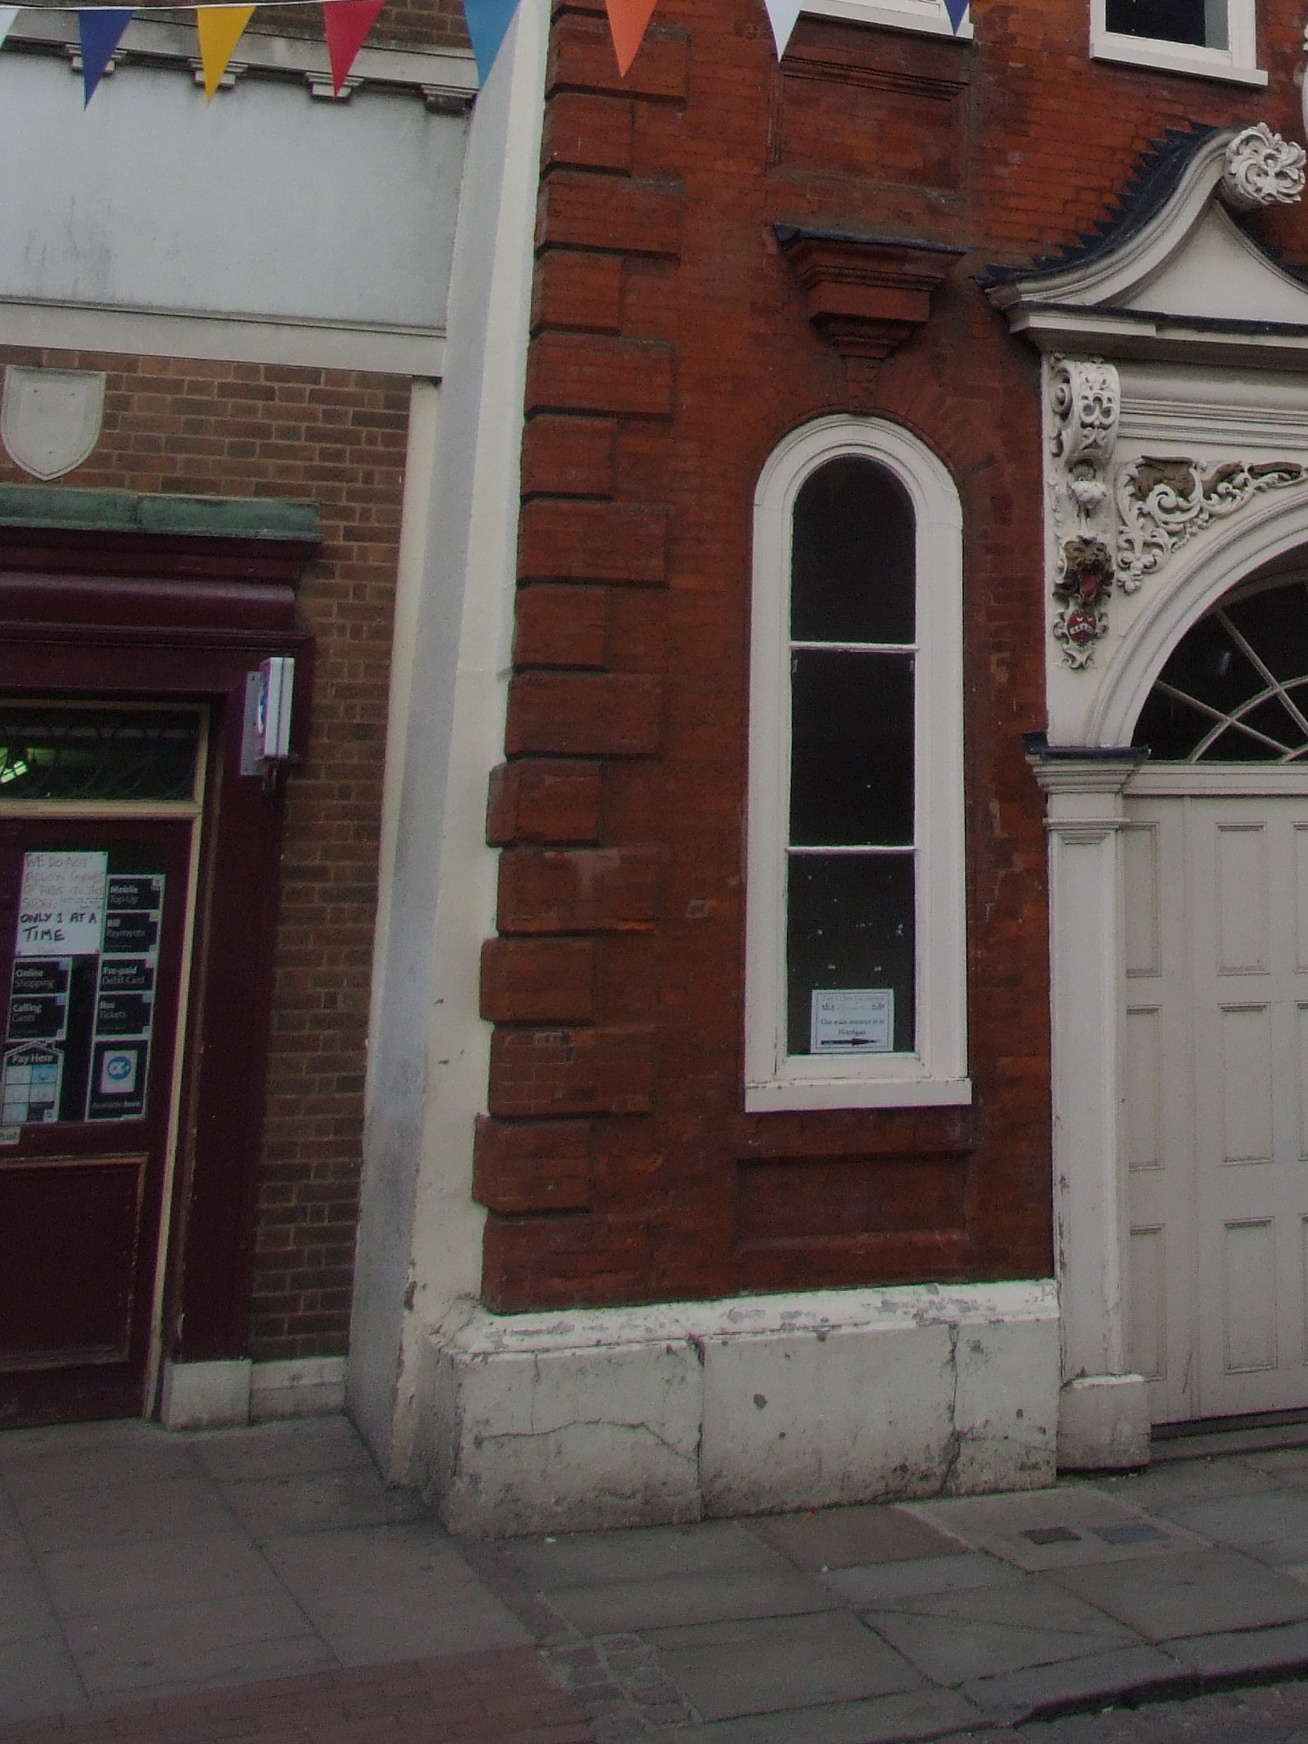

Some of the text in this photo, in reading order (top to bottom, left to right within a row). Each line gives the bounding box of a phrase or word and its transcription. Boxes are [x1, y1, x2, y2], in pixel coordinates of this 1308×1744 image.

[110, 885, 138, 894] Mobile
[21, 912, 97, 924] ONLY 1 AT A
[22, 925, 65, 942] TIME
[107, 929, 146, 939] Payments
[15, 979, 55, 990] Shopping
[102, 976, 145, 985] Debit Card
[13, 1003, 42, 1014] Calling
[100, 1011, 127, 1020] Tickets
[12, 1054, 54, 1065] Pay Here
